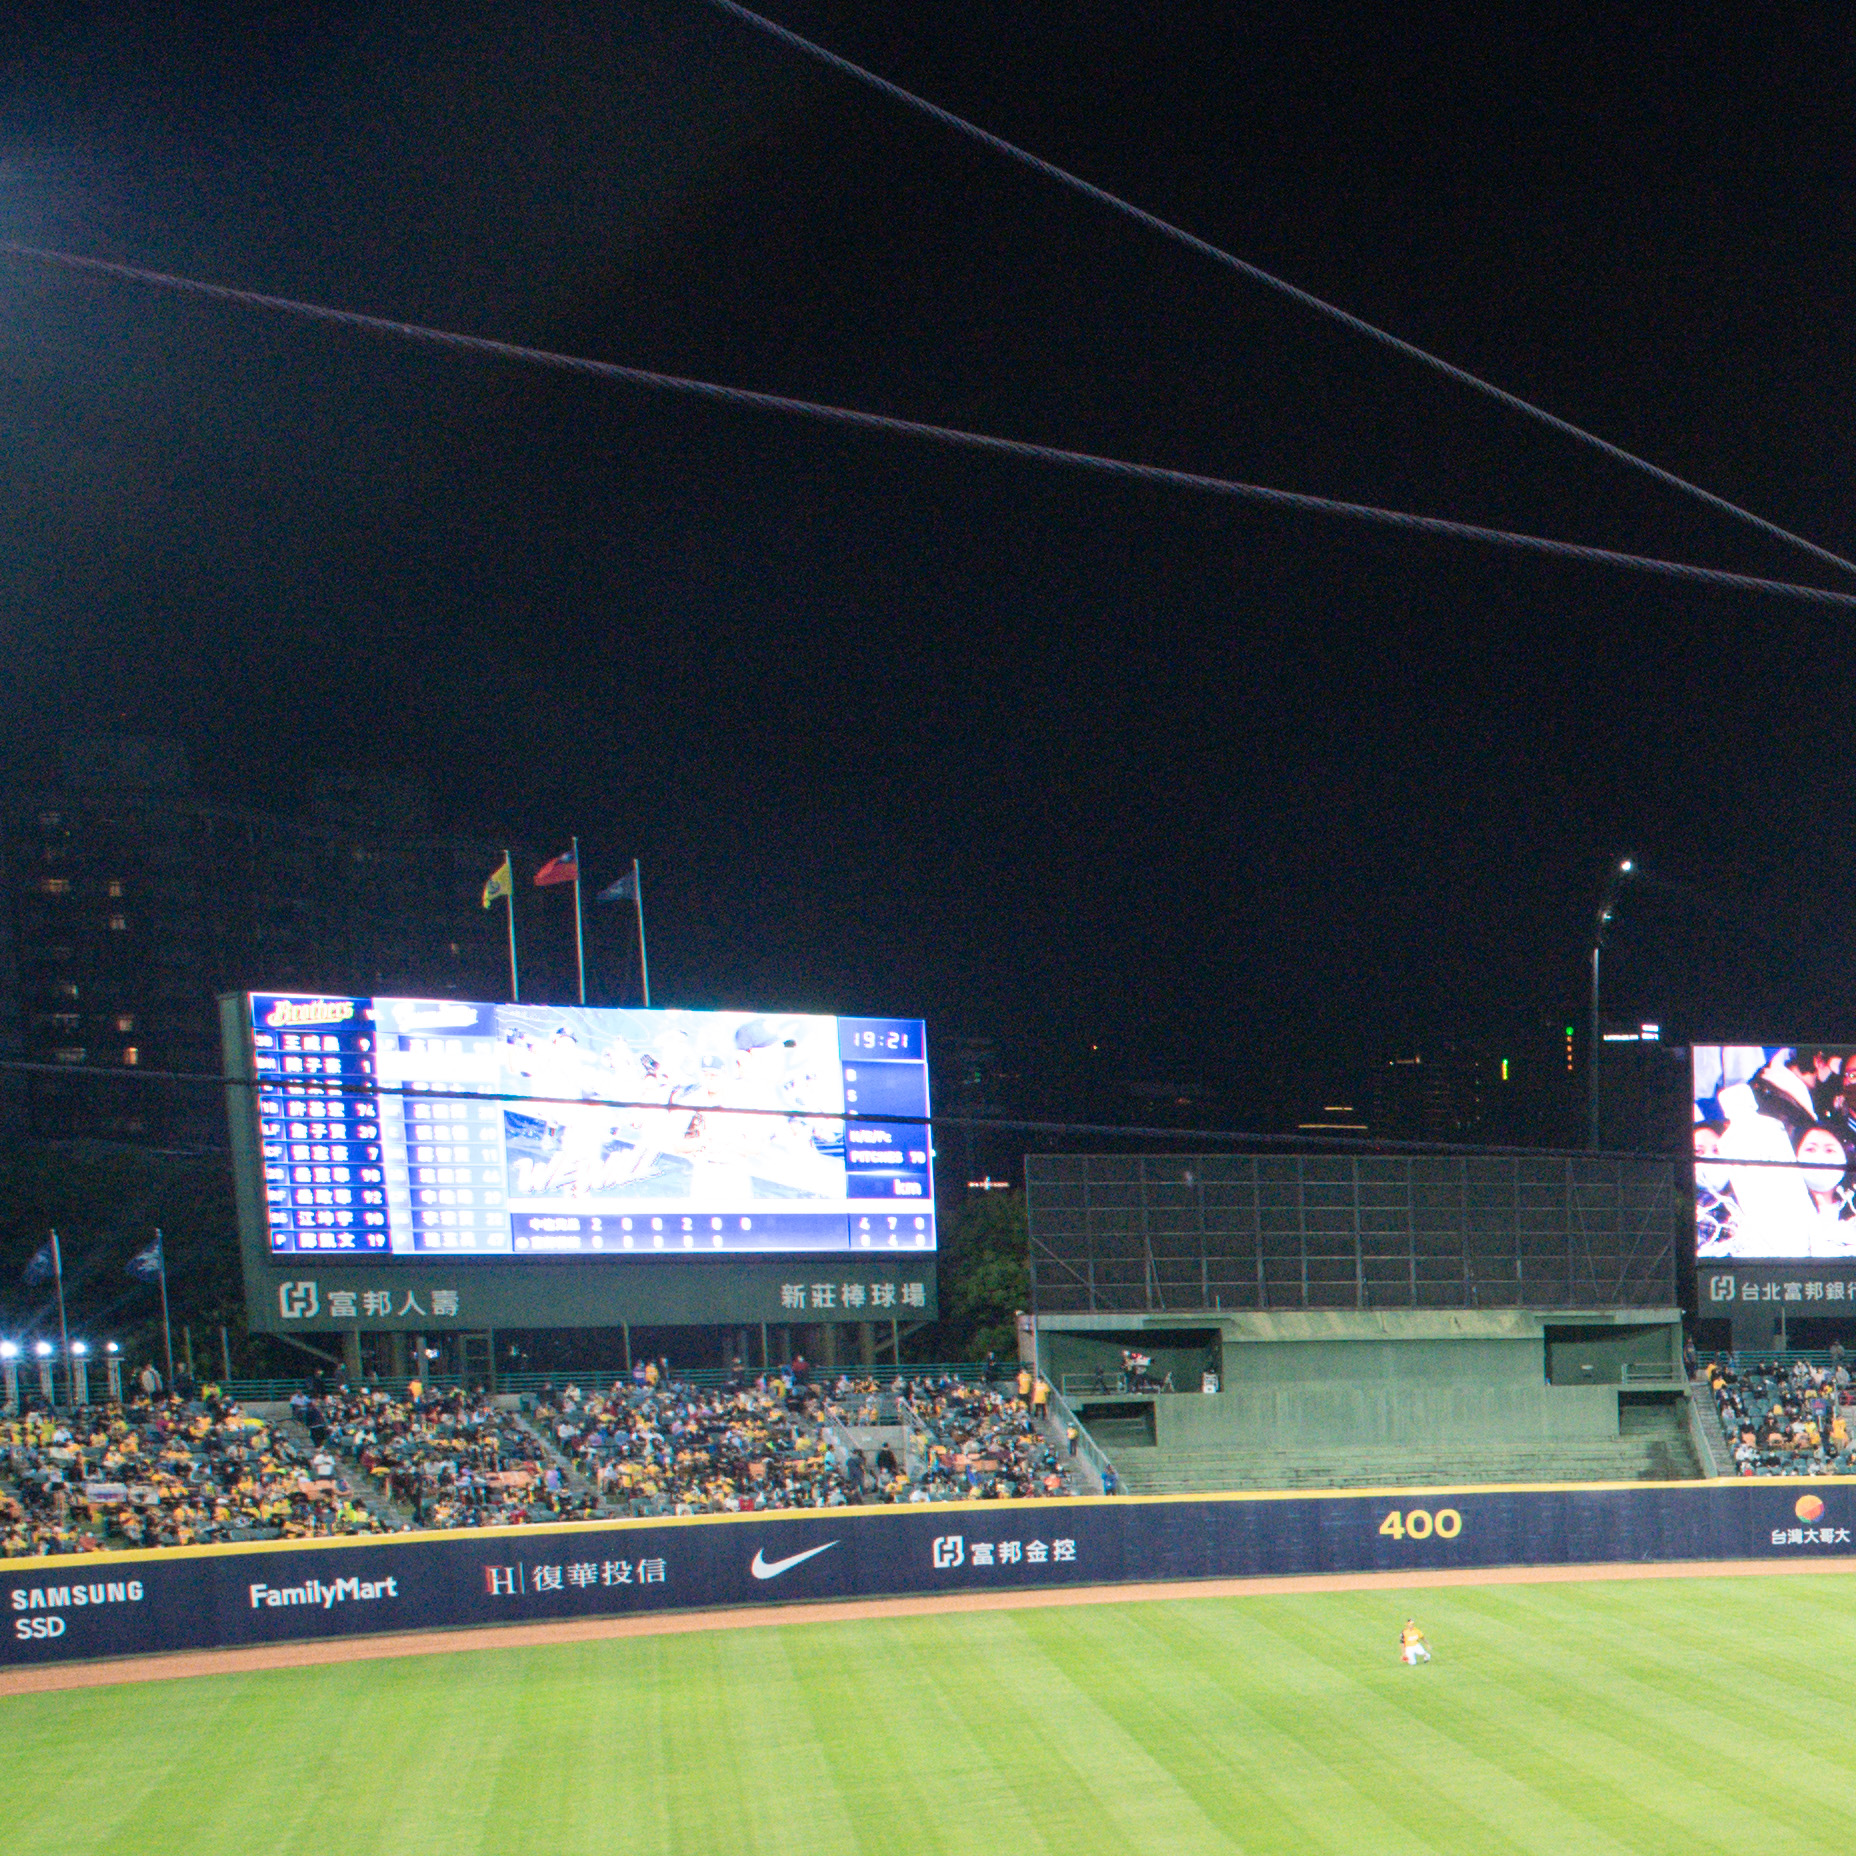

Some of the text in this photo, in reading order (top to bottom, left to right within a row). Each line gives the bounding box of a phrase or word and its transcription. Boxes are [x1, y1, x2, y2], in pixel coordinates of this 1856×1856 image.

[266, 1000, 354, 1026] Brothers
[854, 1031, 908, 1049] 19:21
[367, 1146, 379, 1161] 7
[591, 1217, 602, 1231] 2
[682, 1217, 693, 1231] 2
[328, 1290, 459, 1317] 富邦人壽
[781, 1282, 926, 1309] 新莊棒球場
[1380, 1508, 1462, 1540] 400
[1771, 1527, 1851, 1545] 台灣大哥大
[971, 1538, 1077, 1566] 富邦金控
[532, 1557, 667, 1592] 復華投信
[11, 1580, 144, 1611] SAMSUNG
[250, 1575, 398, 1610] FamilyMart
[16, 1617, 66, 1640] SSD
